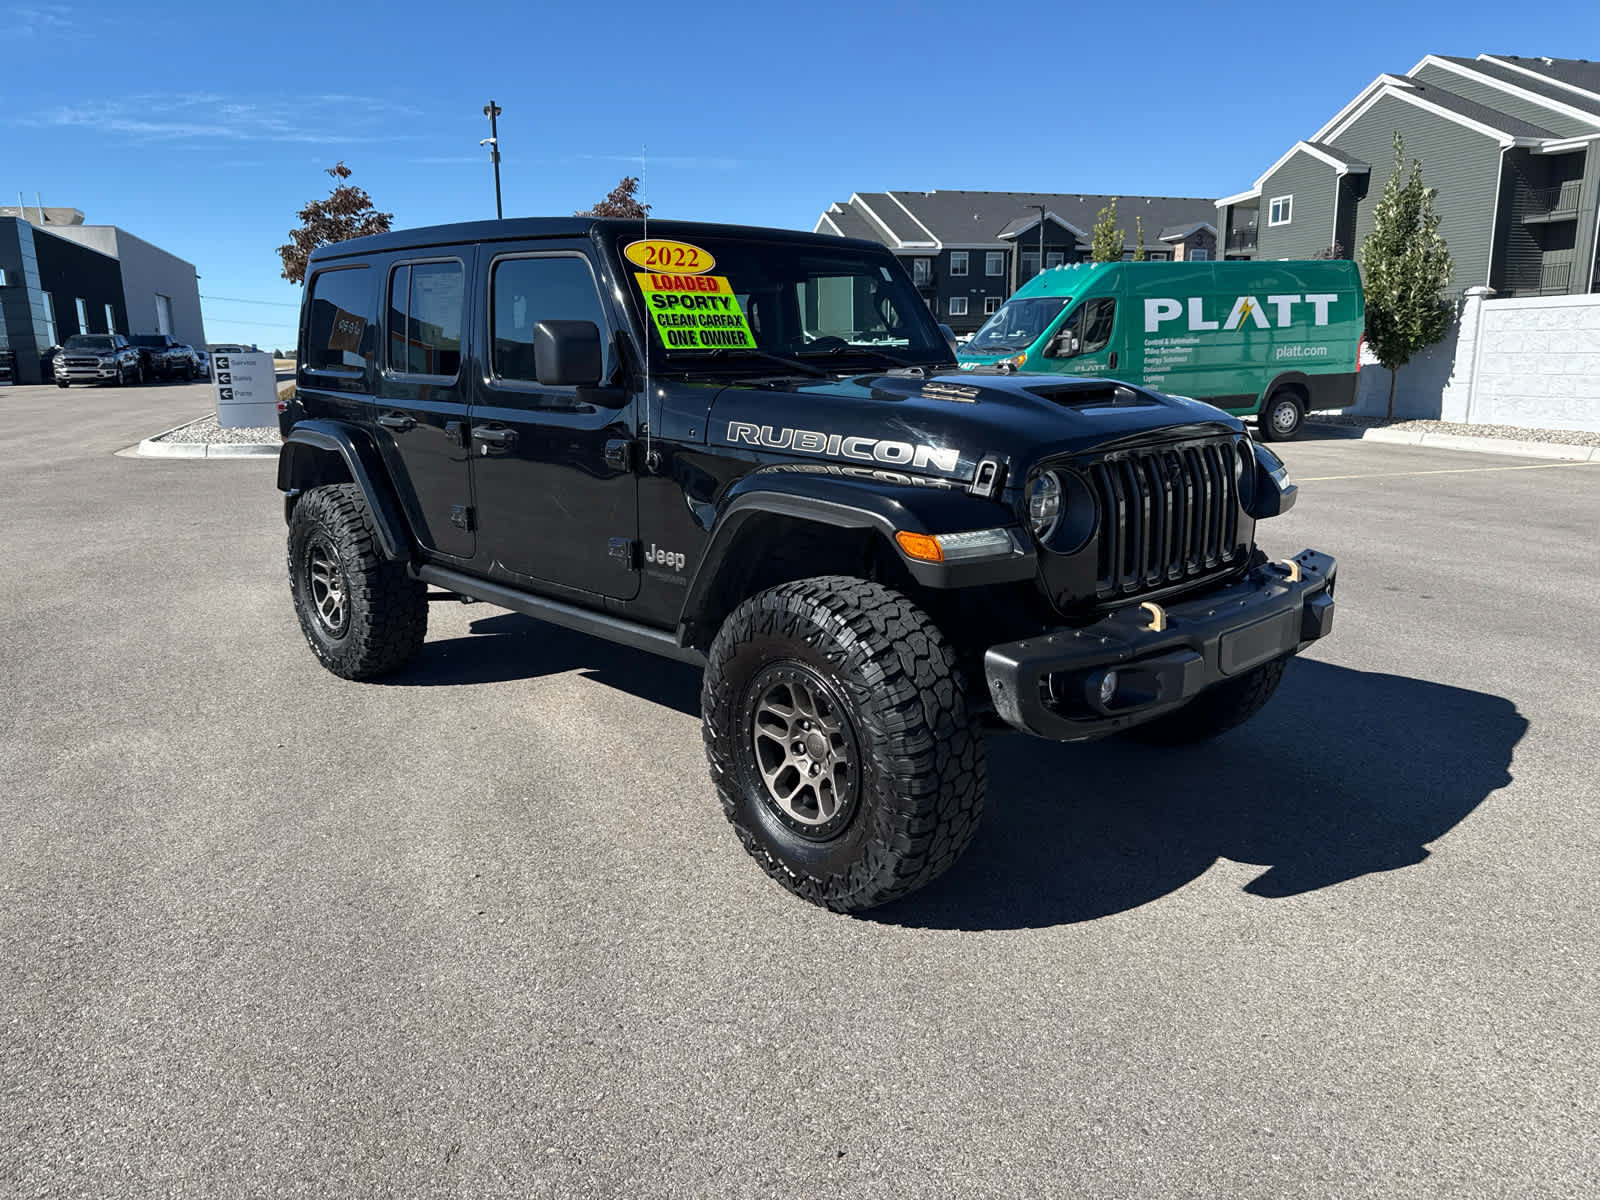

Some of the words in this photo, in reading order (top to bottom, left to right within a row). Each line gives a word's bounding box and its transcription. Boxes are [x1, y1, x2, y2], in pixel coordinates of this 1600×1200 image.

[645, 246, 699, 267] 2022
[651, 274, 720, 292] LOADED
[652, 294, 731, 310] SPORTY
[657, 313, 697, 328] CLEAN
[699, 314, 744, 328] CARFAX
[1143, 293, 1338, 333] PLATT
[668, 330, 697, 345] ONE
[700, 330, 748, 346] OWNER
[1276, 346, 1328, 360] platt.com
[727, 421, 960, 471] RUBICON
[645, 543, 686, 572] Jeep
